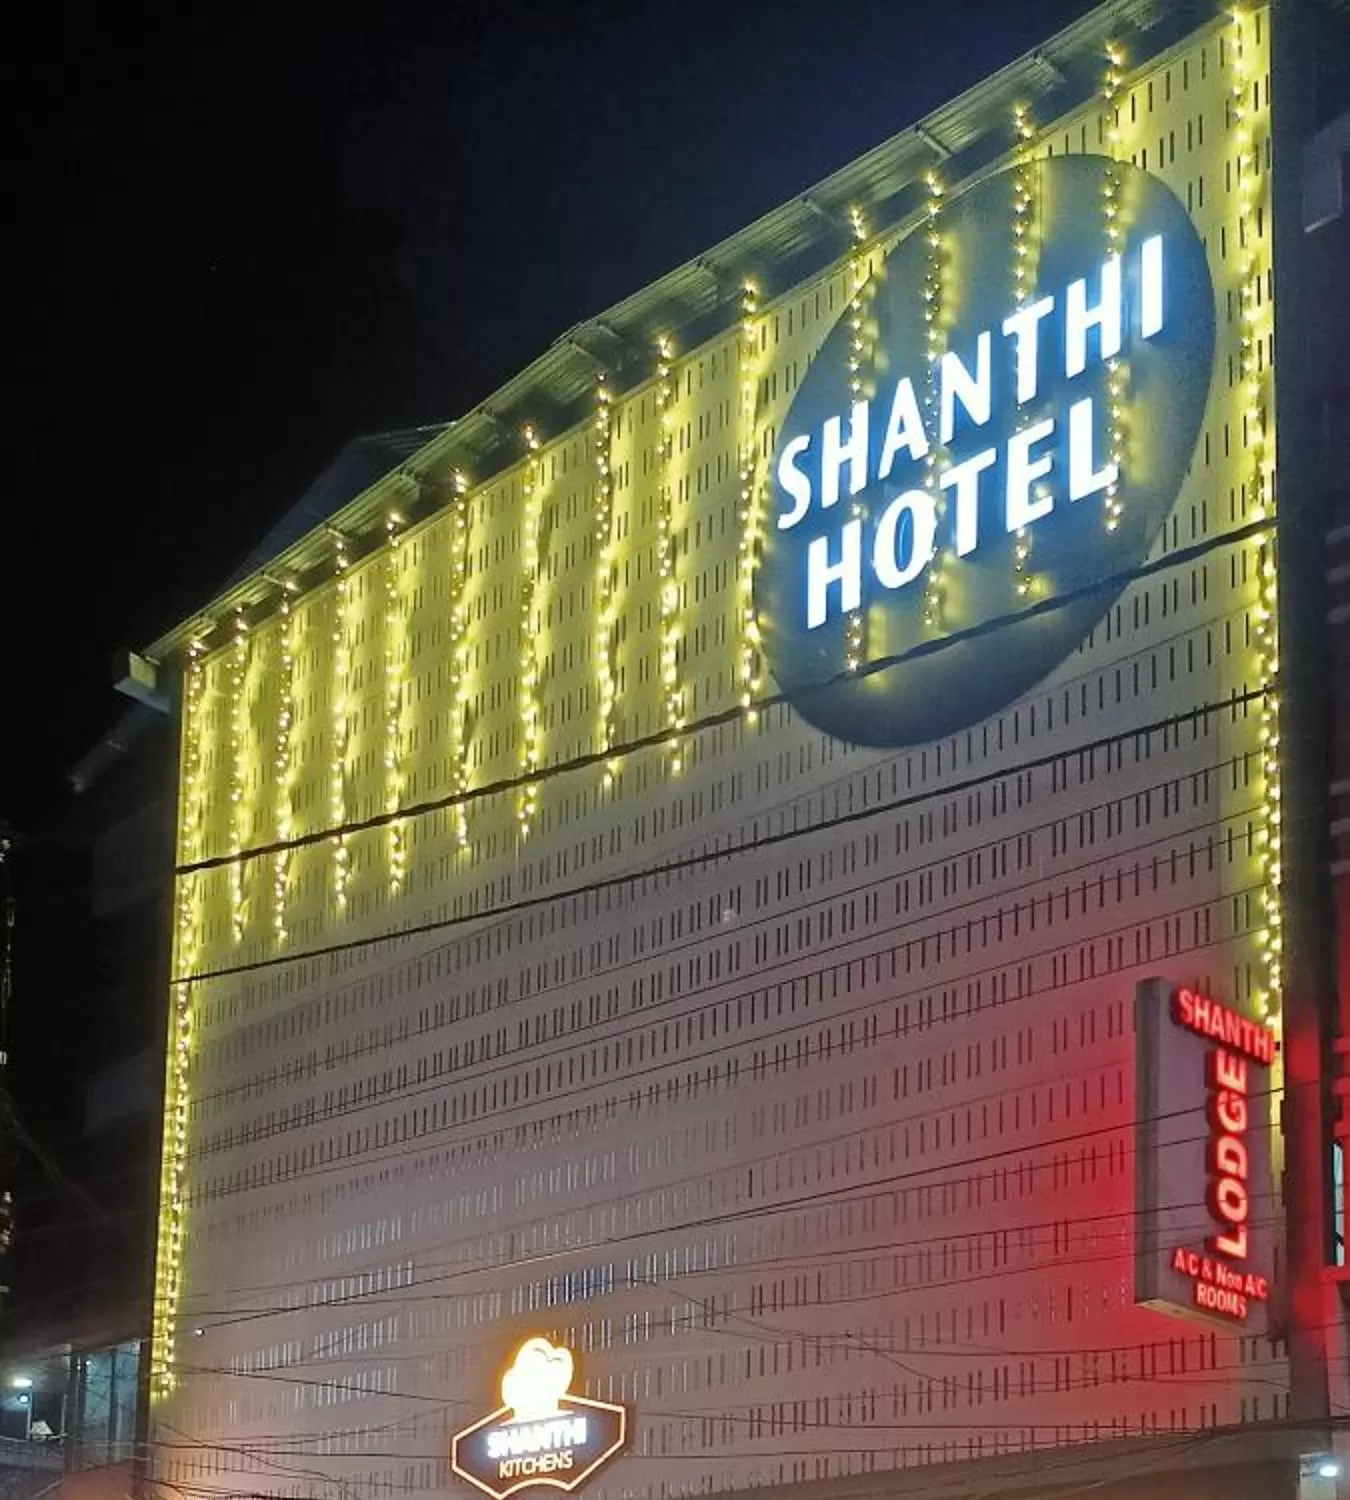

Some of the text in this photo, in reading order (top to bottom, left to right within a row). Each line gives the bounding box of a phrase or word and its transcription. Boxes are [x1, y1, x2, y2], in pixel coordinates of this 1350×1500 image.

[776, 234, 1164, 530] SHANTHI
[806, 397, 1119, 631] HOTEL
[1177, 987, 1276, 1064] SHANTHI
[1216, 1050, 1249, 1260] LODGE
[1197, 1282, 1247, 1319] ROOMS
[1215, 1262, 1243, 1292] Non
[499, 1450, 573, 1479] KITCHENS
